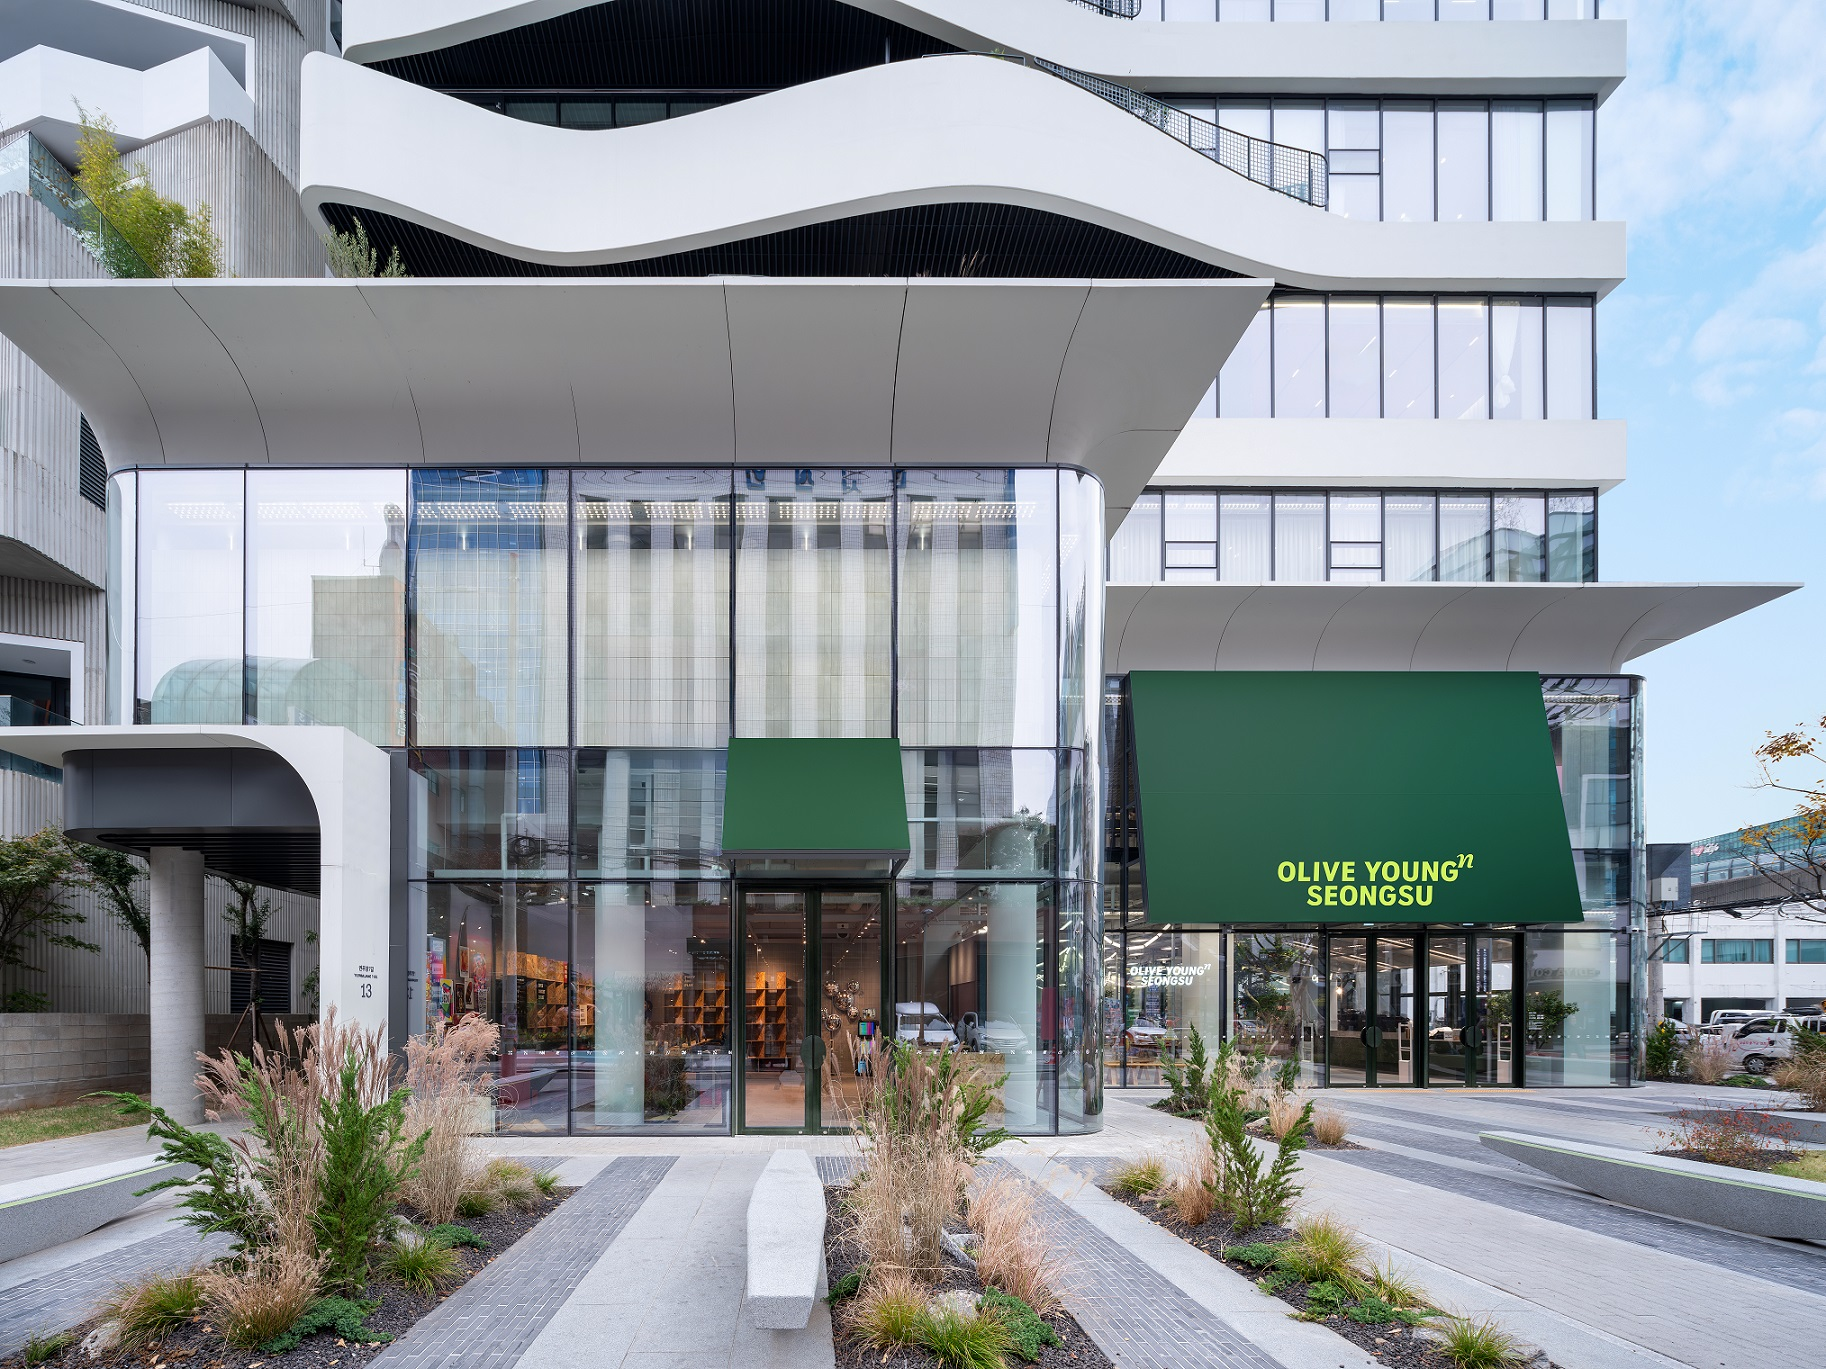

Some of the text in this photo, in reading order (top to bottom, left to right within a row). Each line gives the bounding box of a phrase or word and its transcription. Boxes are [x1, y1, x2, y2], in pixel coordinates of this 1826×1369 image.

[1277, 861, 1356, 882] OLIVE
[1306, 885, 1434, 906] SEONGSU
[1129, 966, 1165, 976] OLIVE
[1140, 976, 1194, 986] SEONGSU
[360, 983, 373, 999] 13
